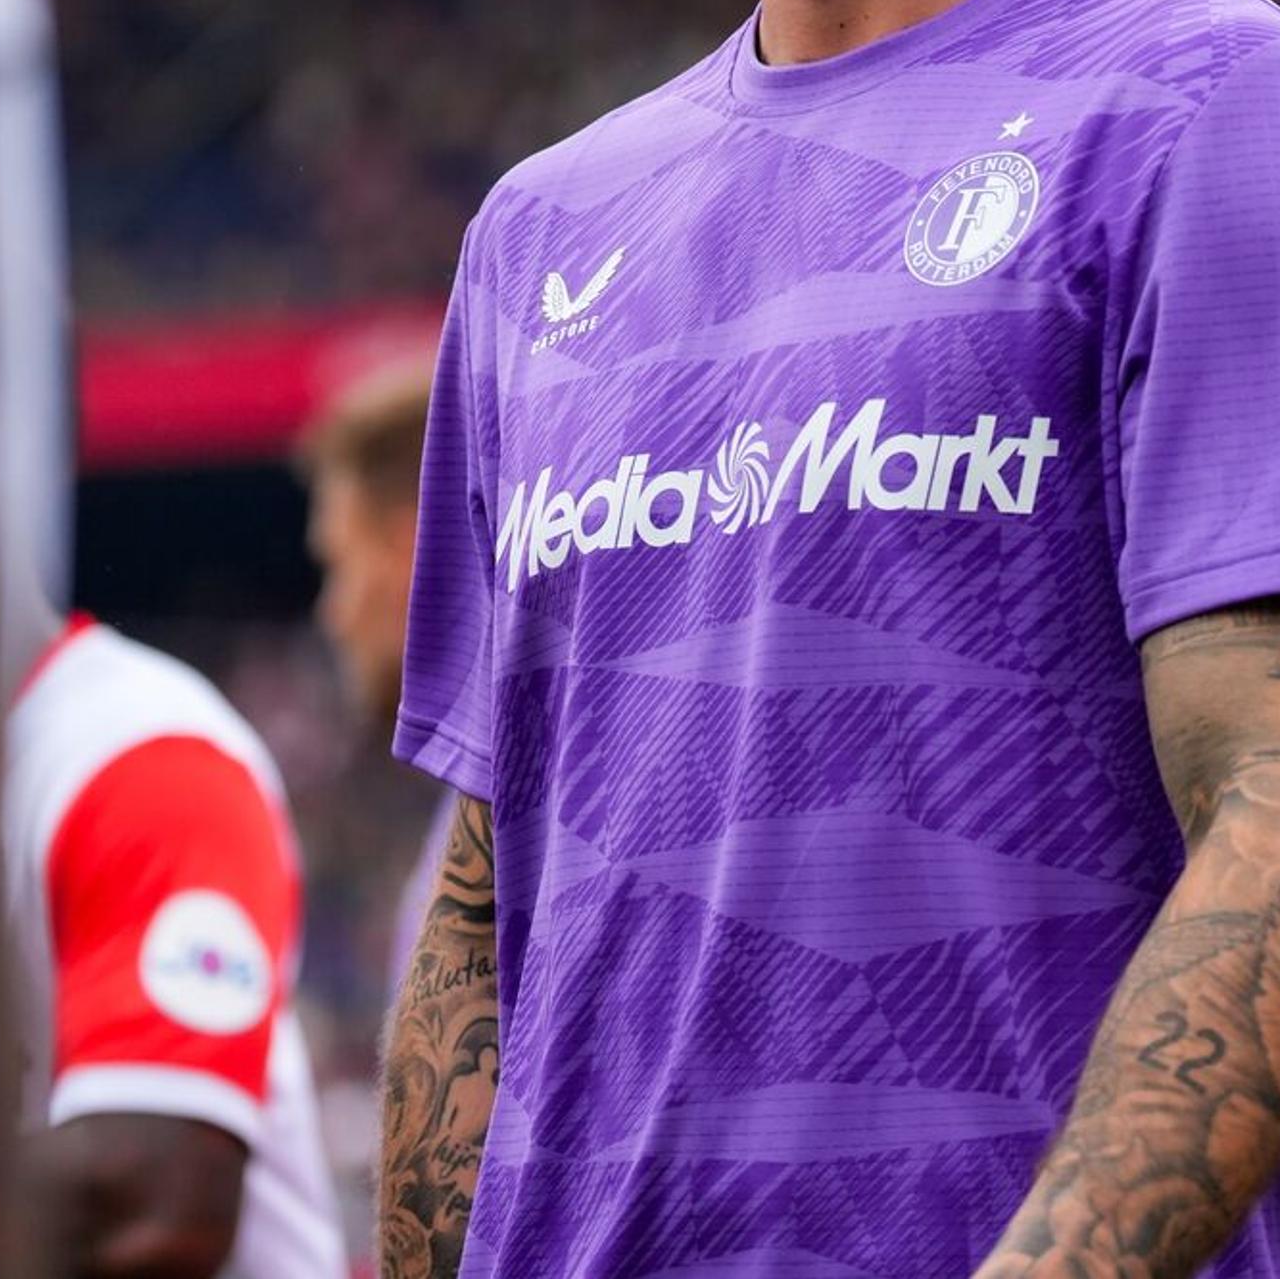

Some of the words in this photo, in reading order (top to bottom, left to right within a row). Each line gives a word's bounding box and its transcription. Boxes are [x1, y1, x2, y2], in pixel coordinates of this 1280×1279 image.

[930, 155, 1034, 204] FEYENOORD
[908, 231, 1015, 281] ROTTERDAM
[530, 315, 600, 356] CASTORE
[1137, 1011, 1227, 1096] 22
